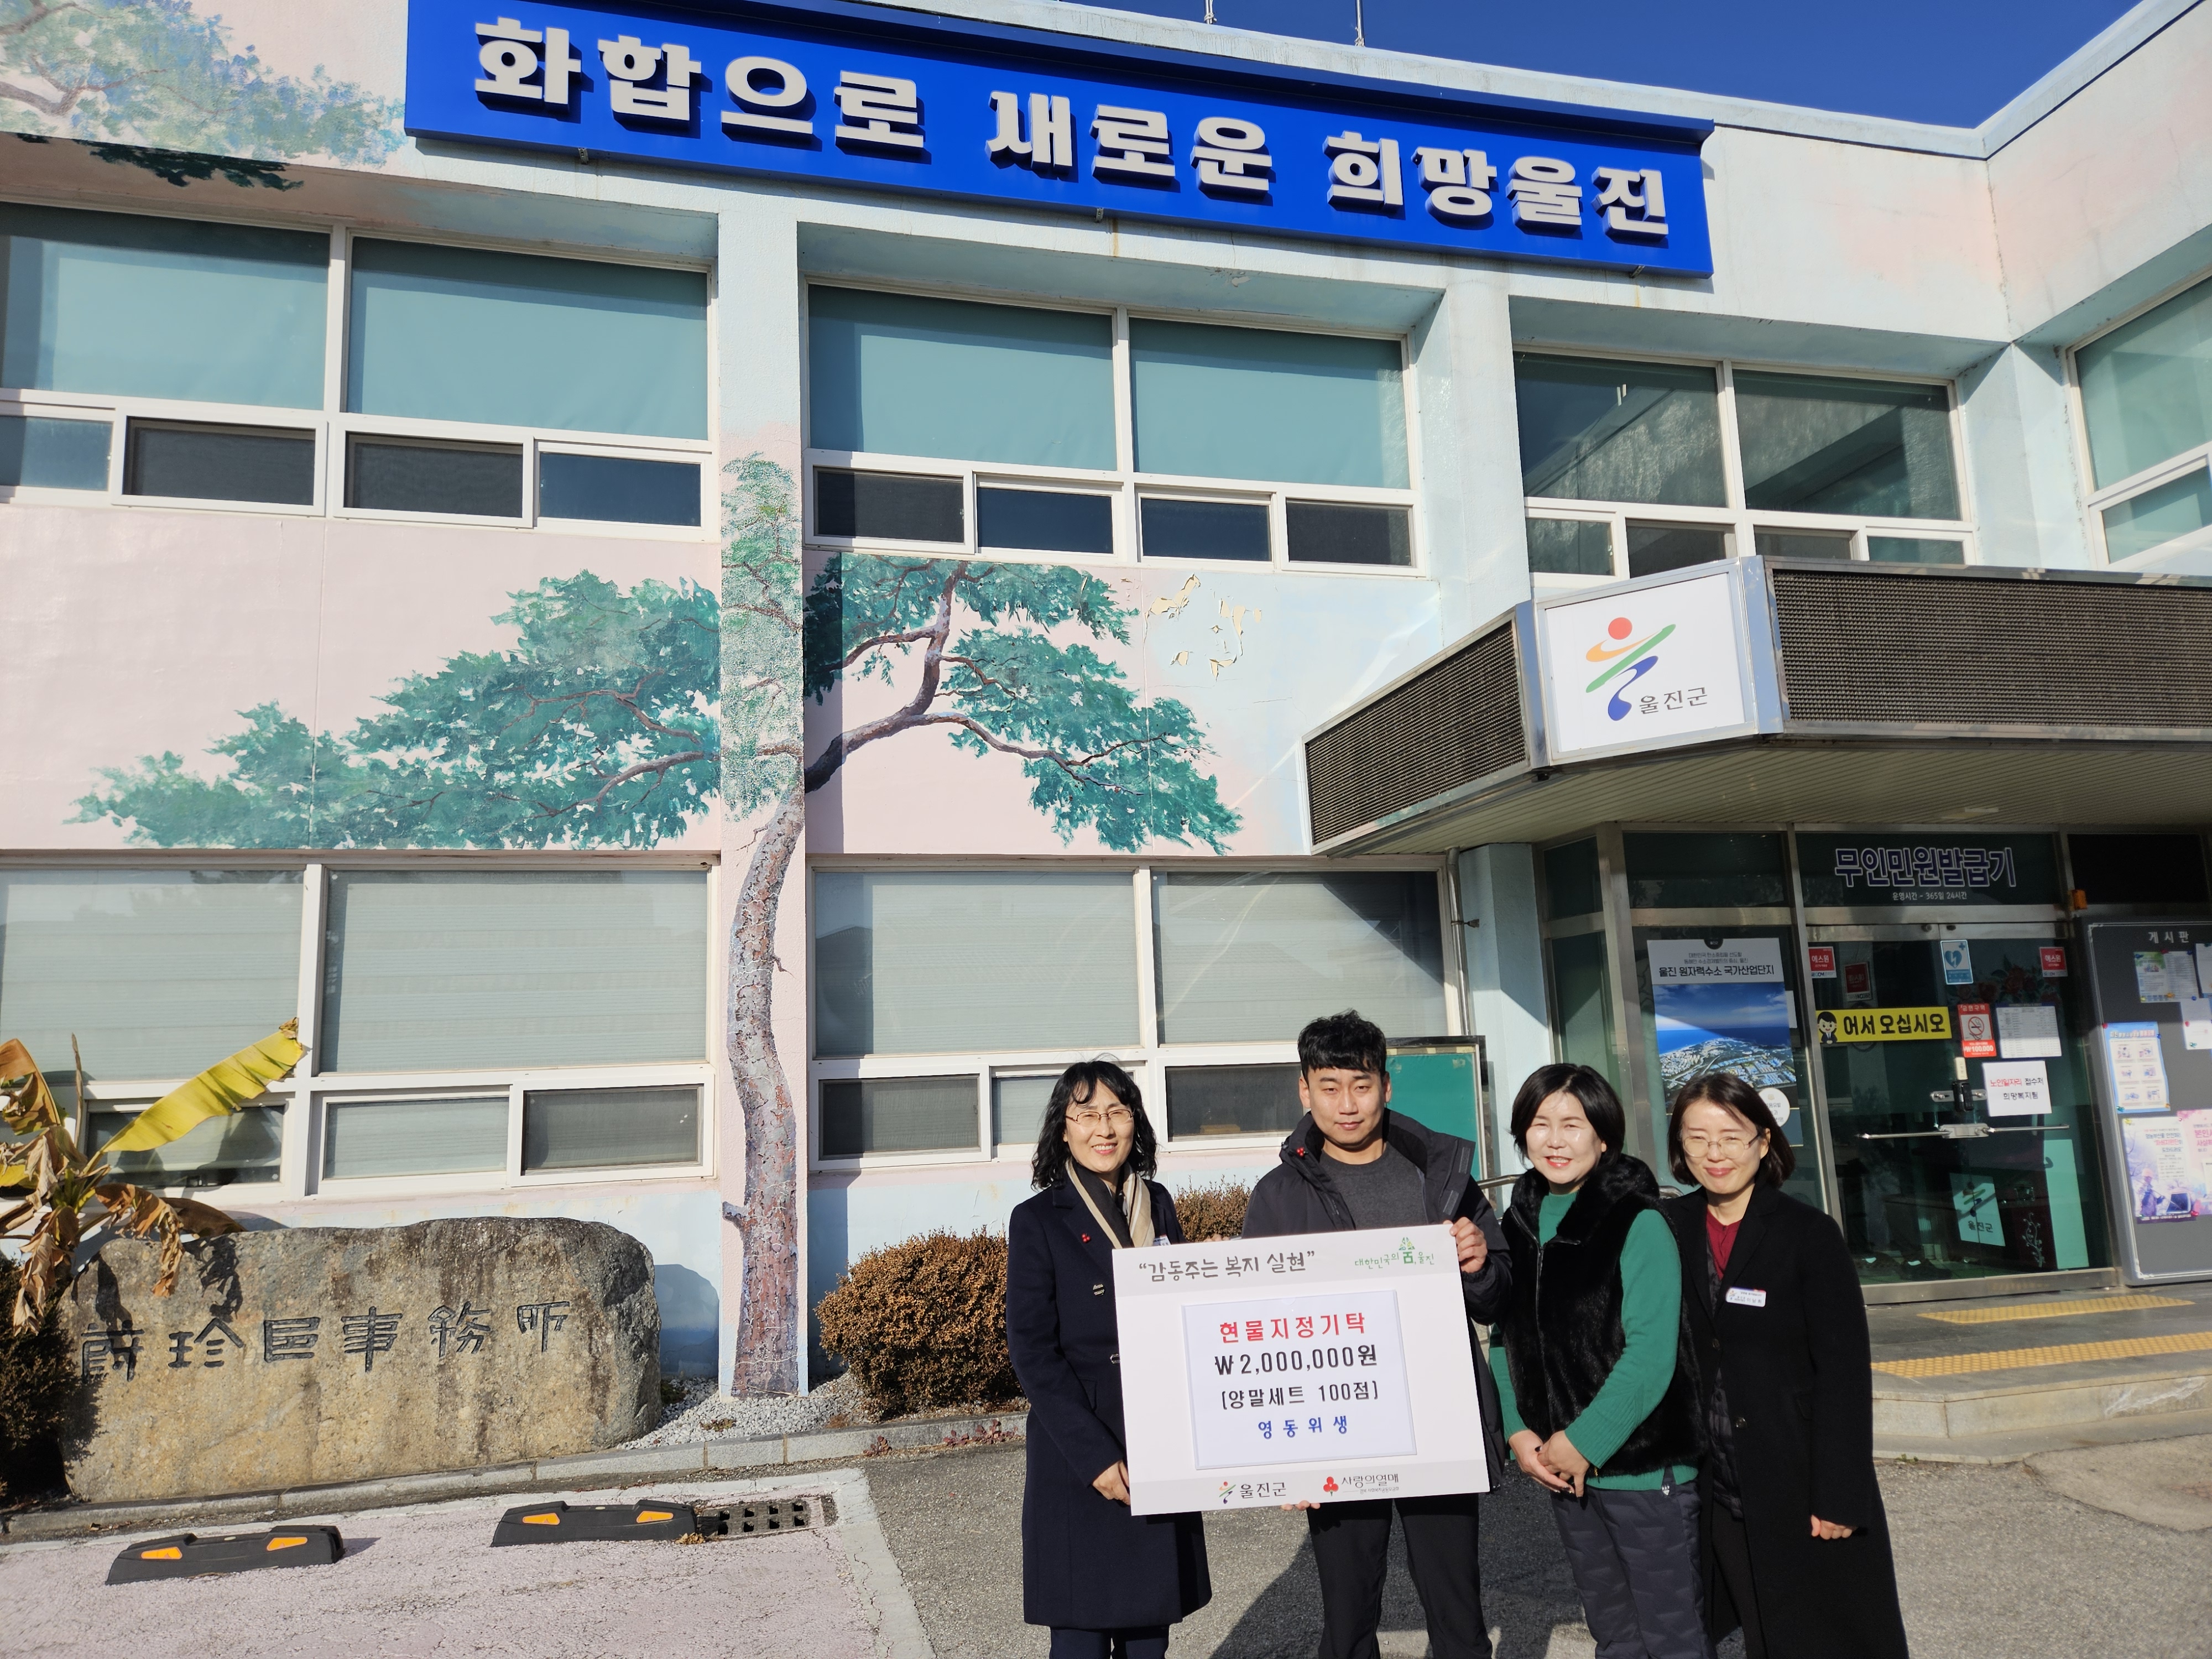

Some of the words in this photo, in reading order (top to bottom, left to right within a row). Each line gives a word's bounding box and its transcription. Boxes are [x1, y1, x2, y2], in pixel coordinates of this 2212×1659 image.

[474, 17, 925, 152] 화합으로
[985, 90, 1273, 196] 새로운
[1324, 131, 1670, 238] 희망울진
[1639, 686, 1708, 714] 울진군
[1834, 847, 2016, 887] 무인민원발급기
[1892, 892, 1917, 901] 운영시간
[1926, 891, 1944, 900] 365일
[1947, 891, 1967, 900] 24시간
[2148, 931, 2189, 943] 게시판
[1658, 967, 1677, 977] 울진
[1679, 966, 1723, 977] 원자력수소
[1724, 964, 1775, 975] 국가산업단지
[1843, 1015, 1876, 1035] 어서
[1880, 1014, 1945, 1034] 오십시오
[1990, 1079, 2022, 1087] 노인일자리
[2025, 1078, 2044, 1086] 접수처
[2004, 1092, 2038, 1100] 희망복지팀
[1968, 1220, 1994, 1233] 울진군
[1139, 1259, 1219, 1282] “감동주는
[1225, 1256, 1260, 1277] 복지
[1266, 1251, 1315, 1274] 실현”
[1354, 1252, 1400, 1270] 대한민국의
[1417, 1251, 1435, 1265] 울진
[1219, 1312, 1365, 1344] 현물지정기탁
[1341, 1473, 1399, 1489] 사랑의열매
[1239, 1482, 1287, 1499] 울진군
